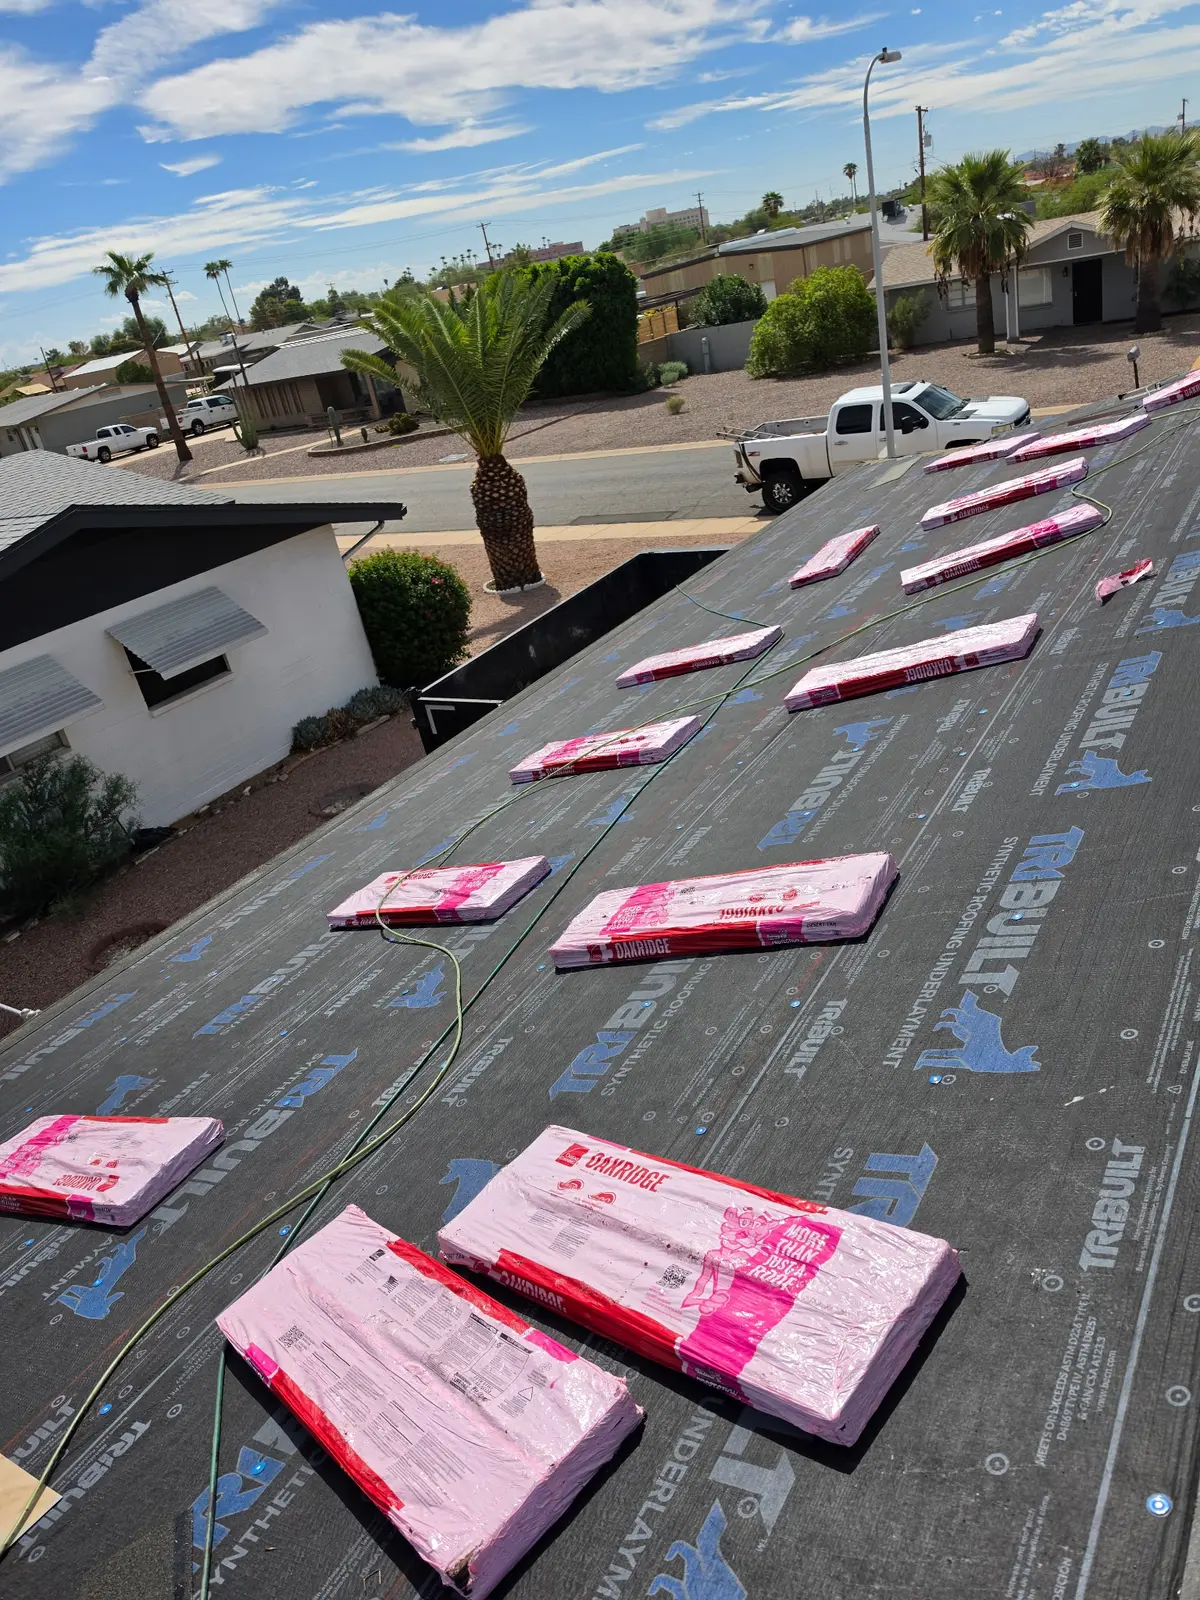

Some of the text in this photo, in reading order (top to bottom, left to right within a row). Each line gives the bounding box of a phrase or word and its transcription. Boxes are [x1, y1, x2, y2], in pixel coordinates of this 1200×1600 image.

[944, 559, 981, 579] OAKRIDGE
[904, 657, 952, 682] OAKRIDGE
[614, 938, 671, 959] OAKRIDGE
[883, 831, 1017, 1068] SYNTHETIC ROOFING UNDERLAYMENT
[598, 960, 711, 1100] SYNTHETIC ROOFING
[247, 1048, 323, 1119] SYNTHETIC
[585, 1152, 671, 1193] OAKRIDGE
[774, 1238, 819, 1263] THAN
[1074, 1300, 1089, 1321] TYPE
[1068, 1321, 1083, 1345] D226
[1082, 1315, 1098, 1342] D8257
[1060, 1344, 1076, 1371] ASTM
[1074, 1342, 1091, 1369] ASTM
[1089, 1335, 1108, 1367] A123.3
[1047, 1371, 1070, 1414] EXCEEDS
[1064, 1382, 1081, 1408] TYPE
[1055, 1408, 1075, 1441] D4869
[1032, 1430, 1054, 1466] MEETS
